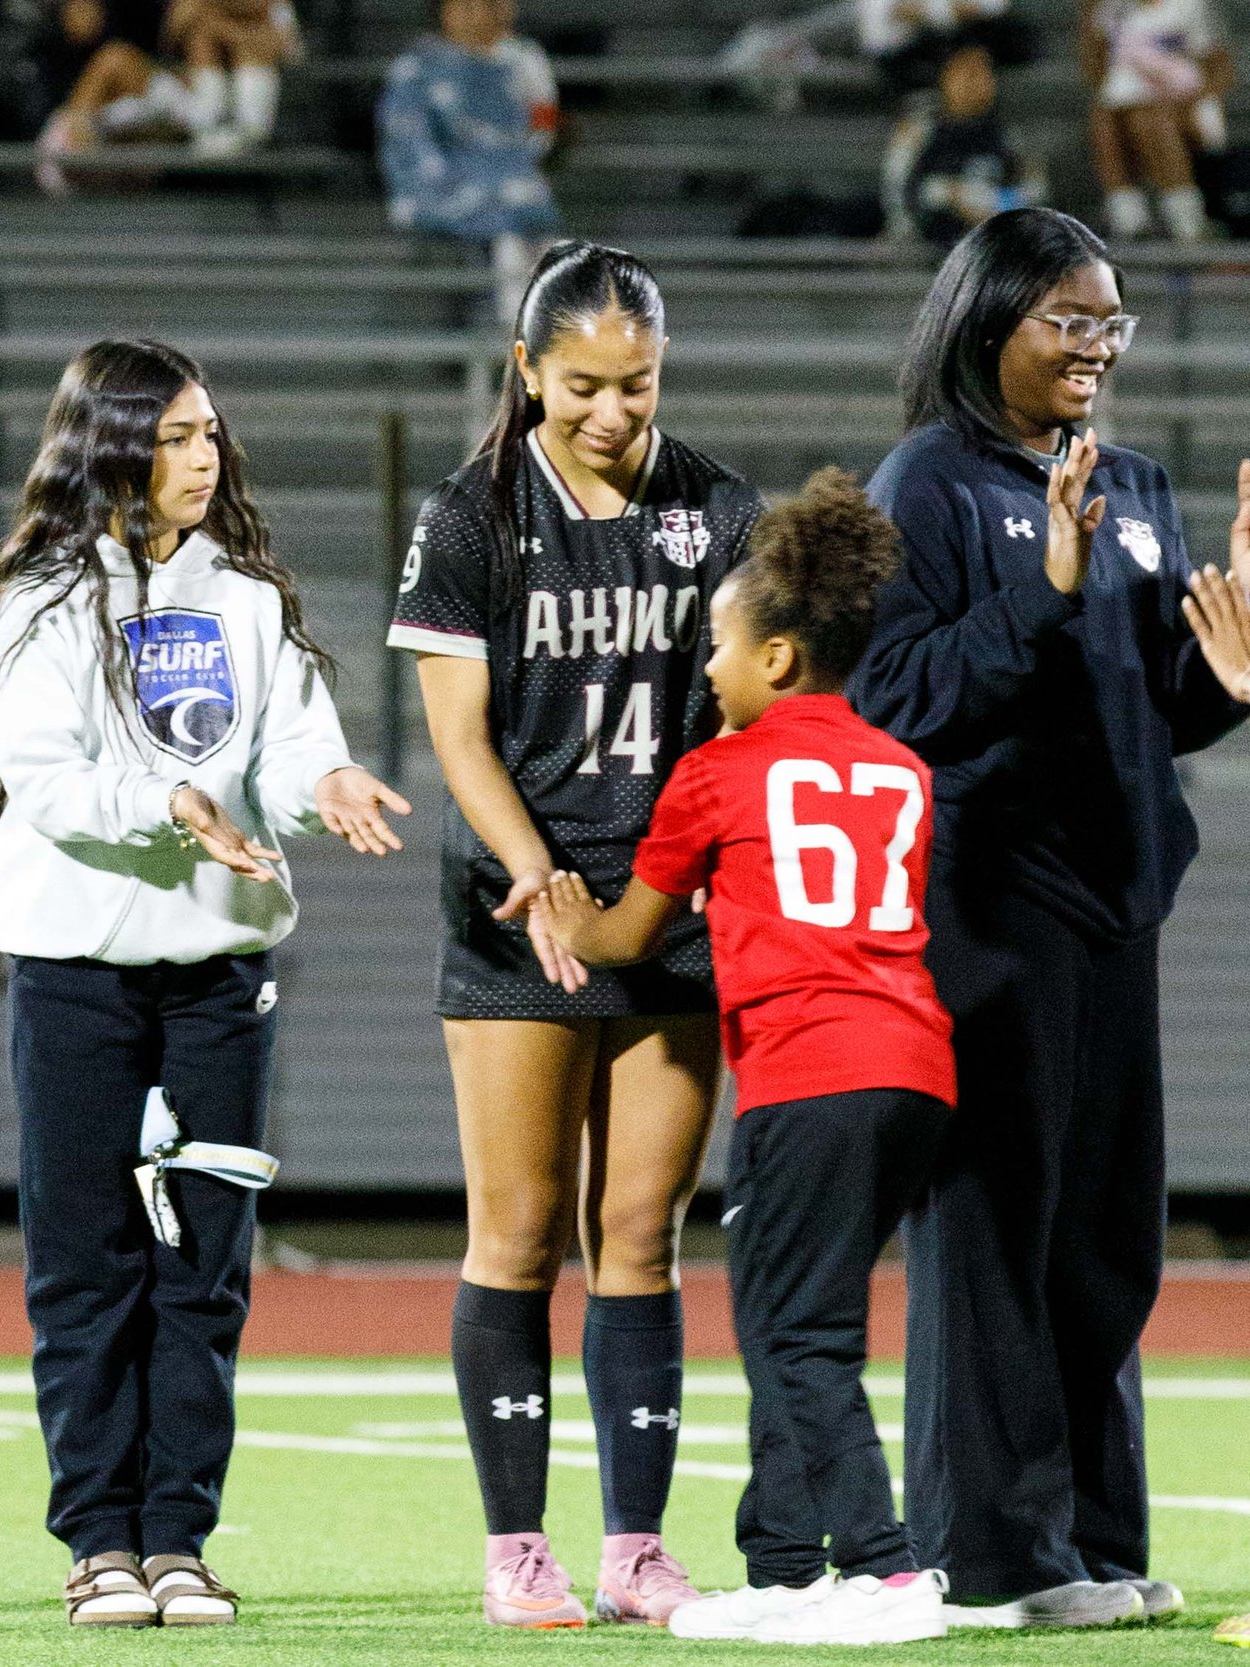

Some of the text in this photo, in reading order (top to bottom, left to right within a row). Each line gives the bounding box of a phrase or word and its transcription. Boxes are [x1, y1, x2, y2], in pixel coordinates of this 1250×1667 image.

[138, 641, 225, 673] SURF
[523, 585, 699, 659] AHMO
[577, 682, 660, 774] 14
[767, 759, 924, 931] 67
